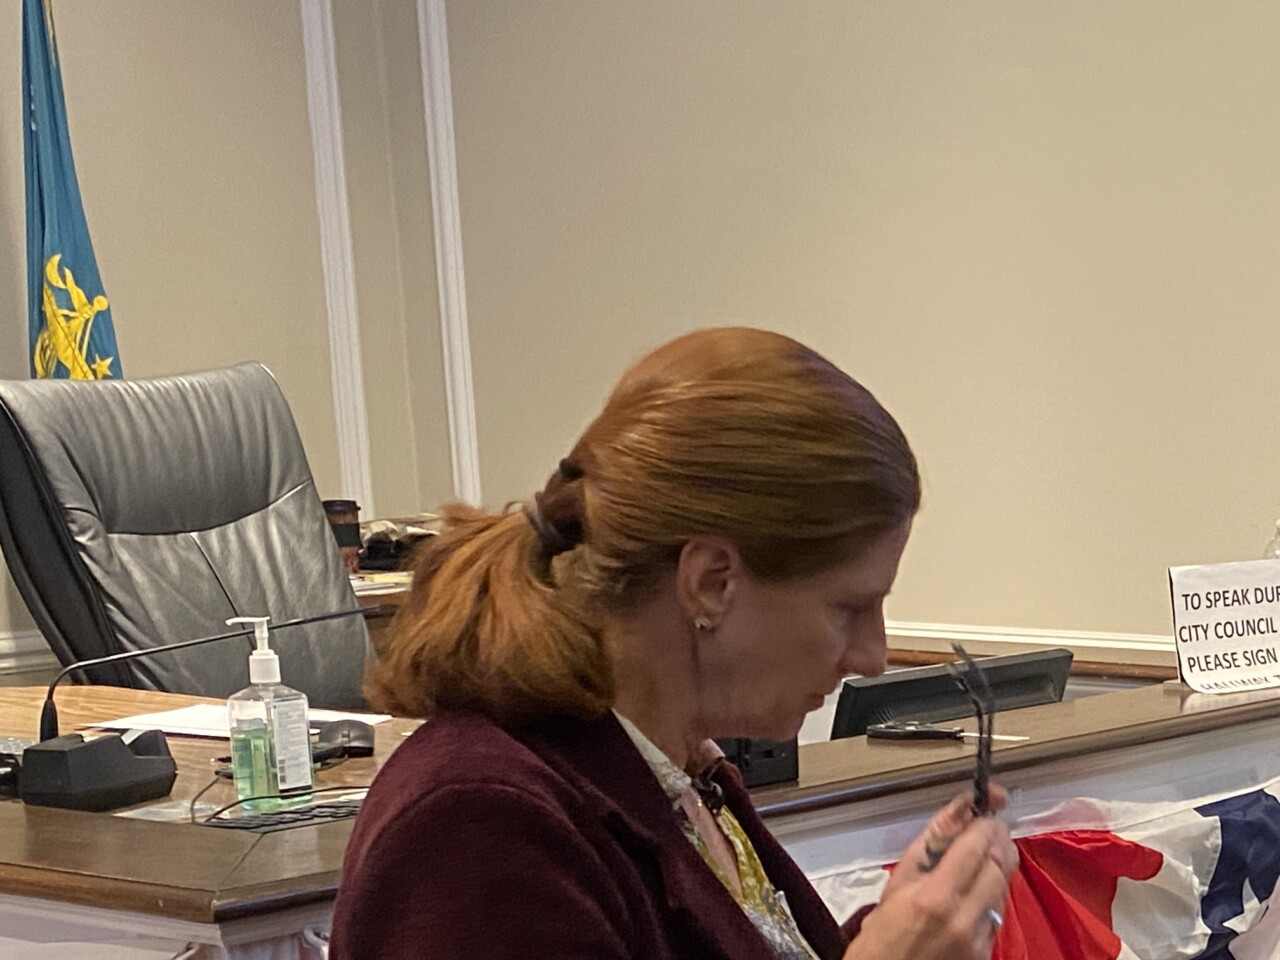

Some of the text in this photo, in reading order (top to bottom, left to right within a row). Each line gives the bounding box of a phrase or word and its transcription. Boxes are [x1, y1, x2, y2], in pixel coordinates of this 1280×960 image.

[1182, 592, 1202, 611] TO
[1205, 588, 1251, 609] SPEAK
[1179, 623, 1209, 643] CITY
[1214, 617, 1278, 639] COUNCIL
[1187, 652, 1241, 673] PLEASE
[1242, 647, 1279, 667] SIGN
